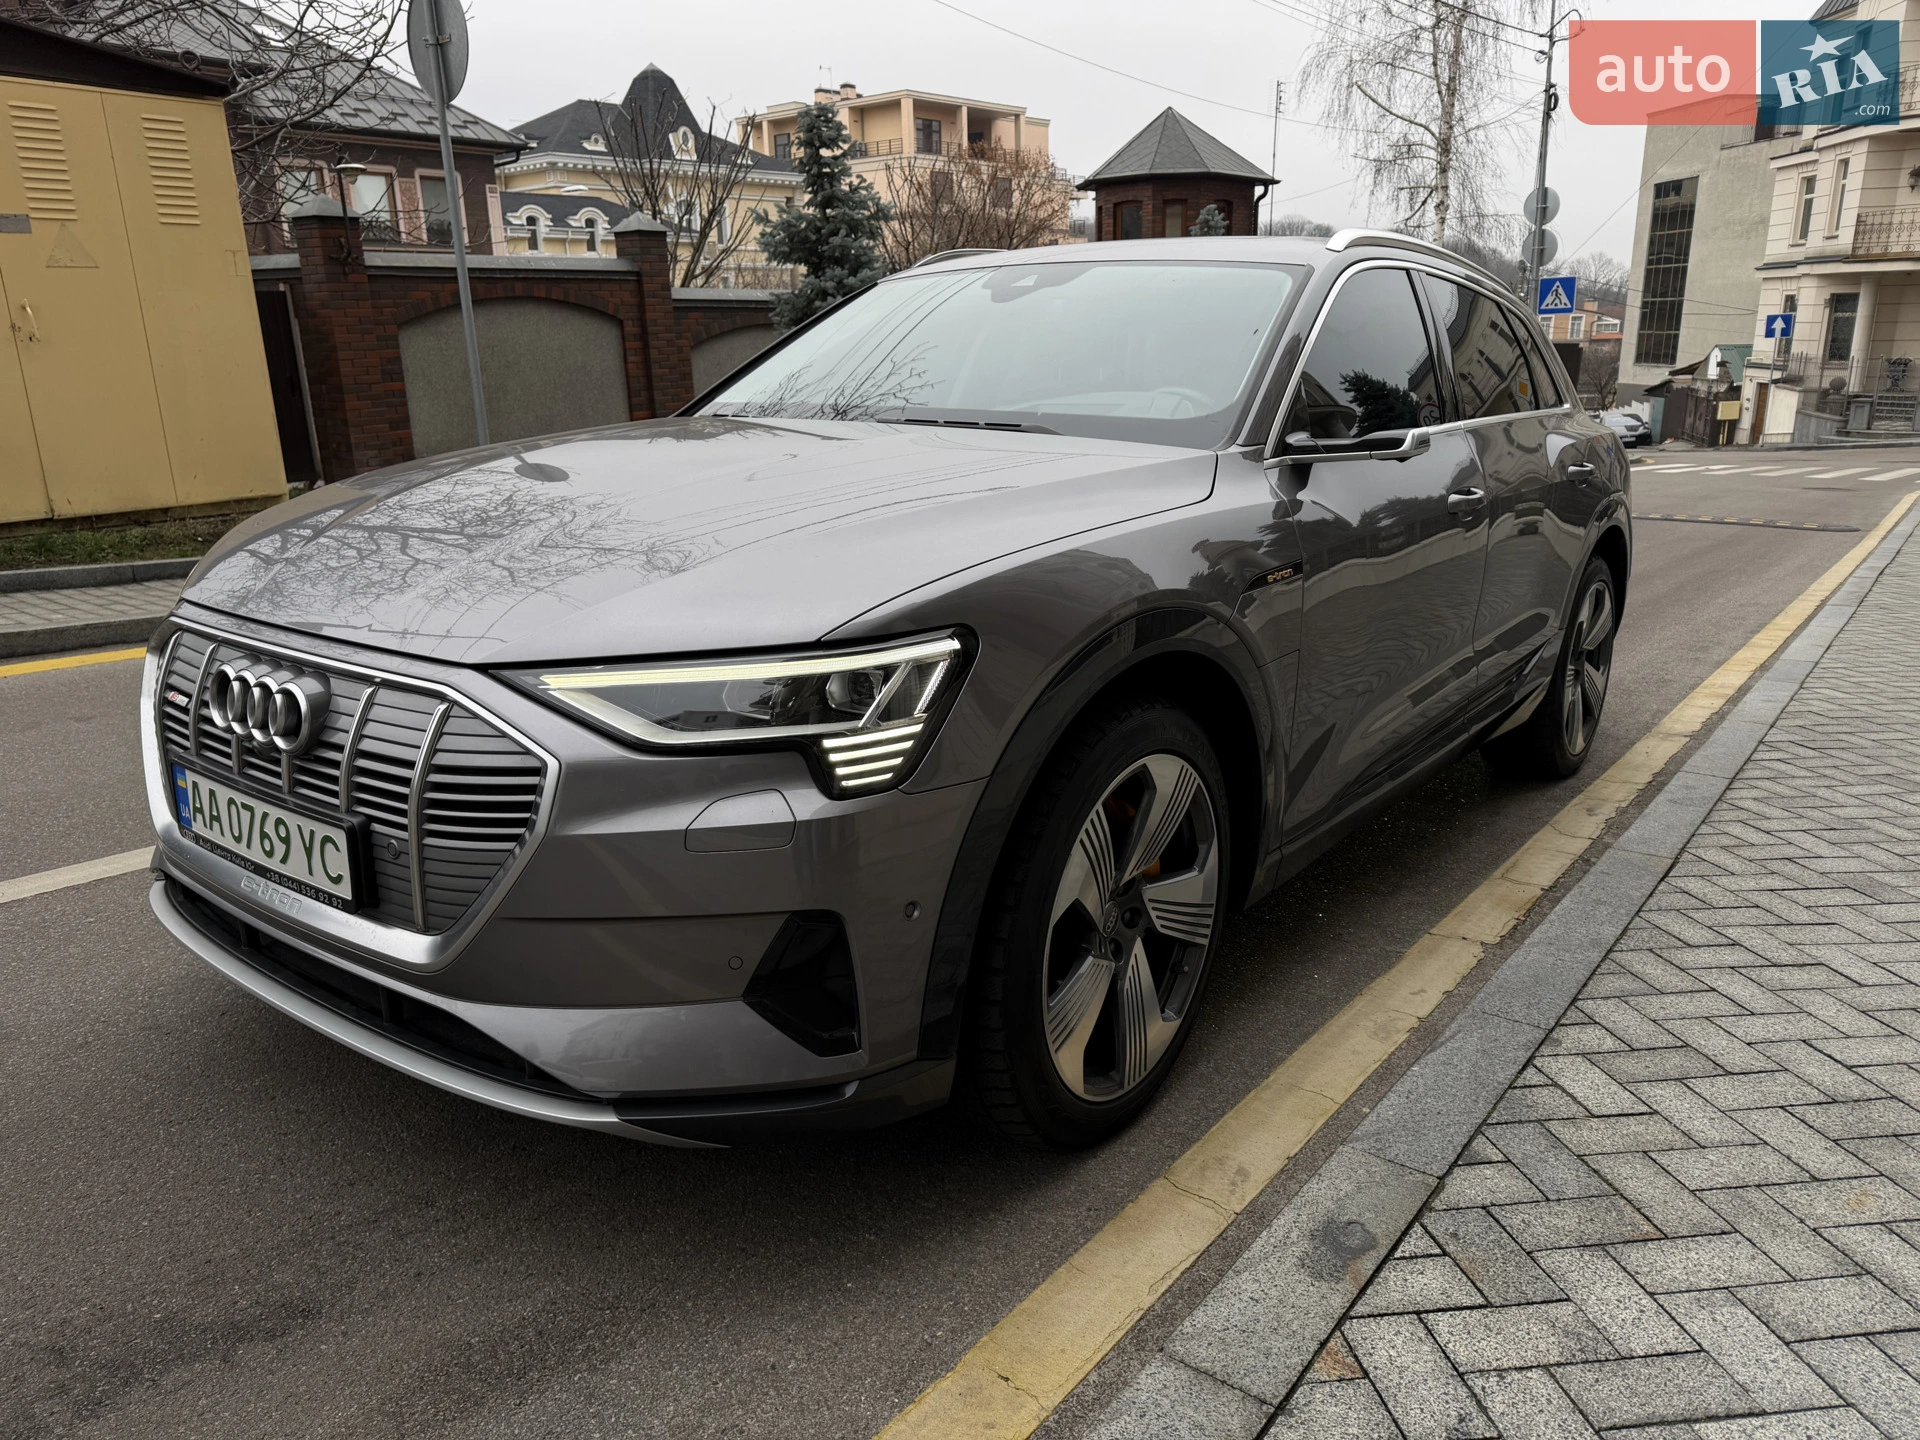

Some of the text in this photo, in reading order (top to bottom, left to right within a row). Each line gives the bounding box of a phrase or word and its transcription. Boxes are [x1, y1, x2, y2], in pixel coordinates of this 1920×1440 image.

[1267, 568, 1294, 583] e-tron
[180, 803, 190, 820] UA
[241, 875, 303, 914] e-tron
[266, 871, 280, 883] +38
[281, 876, 300, 892] (044)
[301, 885, 316, 898] 536
[318, 892, 329, 904] 92
[331, 897, 344, 909] 92
